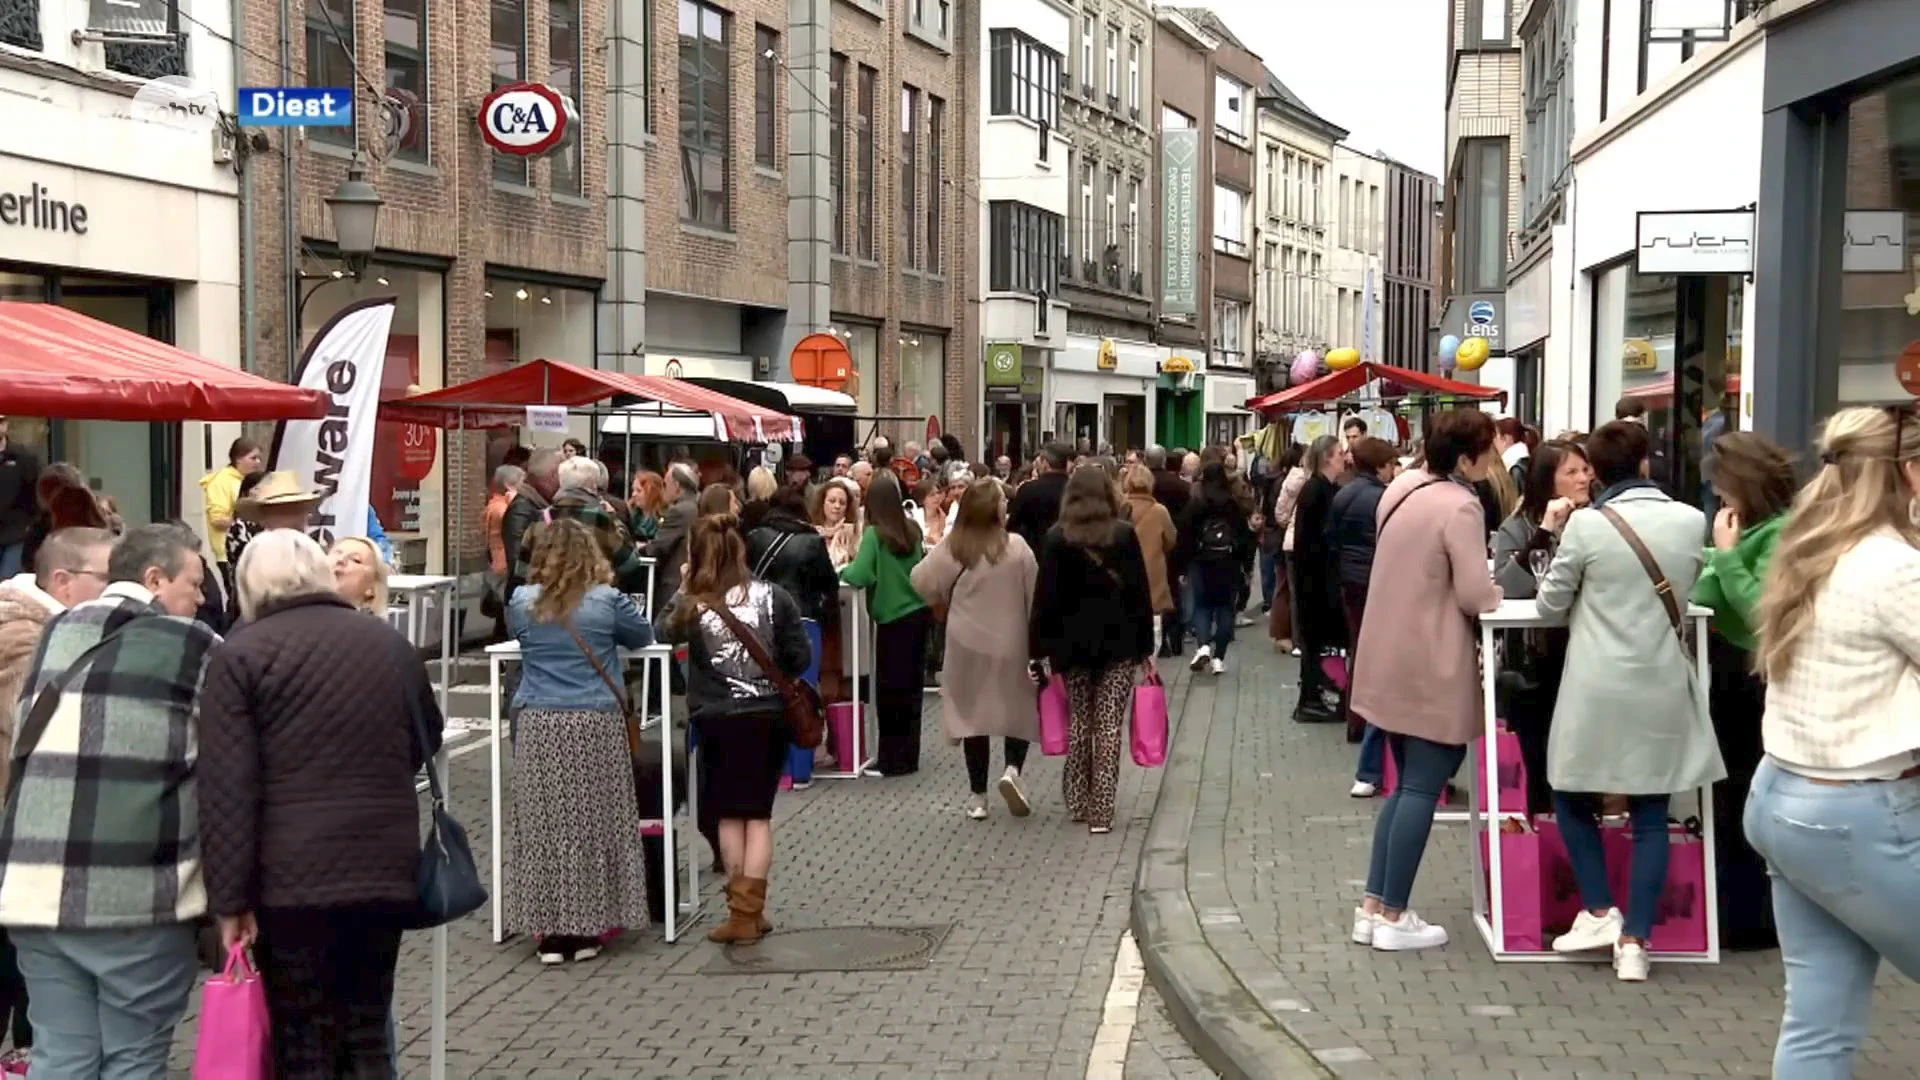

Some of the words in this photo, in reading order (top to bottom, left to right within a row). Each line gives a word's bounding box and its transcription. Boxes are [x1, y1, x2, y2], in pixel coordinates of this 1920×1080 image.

[493, 102, 550, 134] C&A
[0, 182, 88, 236] erline
[1463, 322, 1499, 336] Lens
